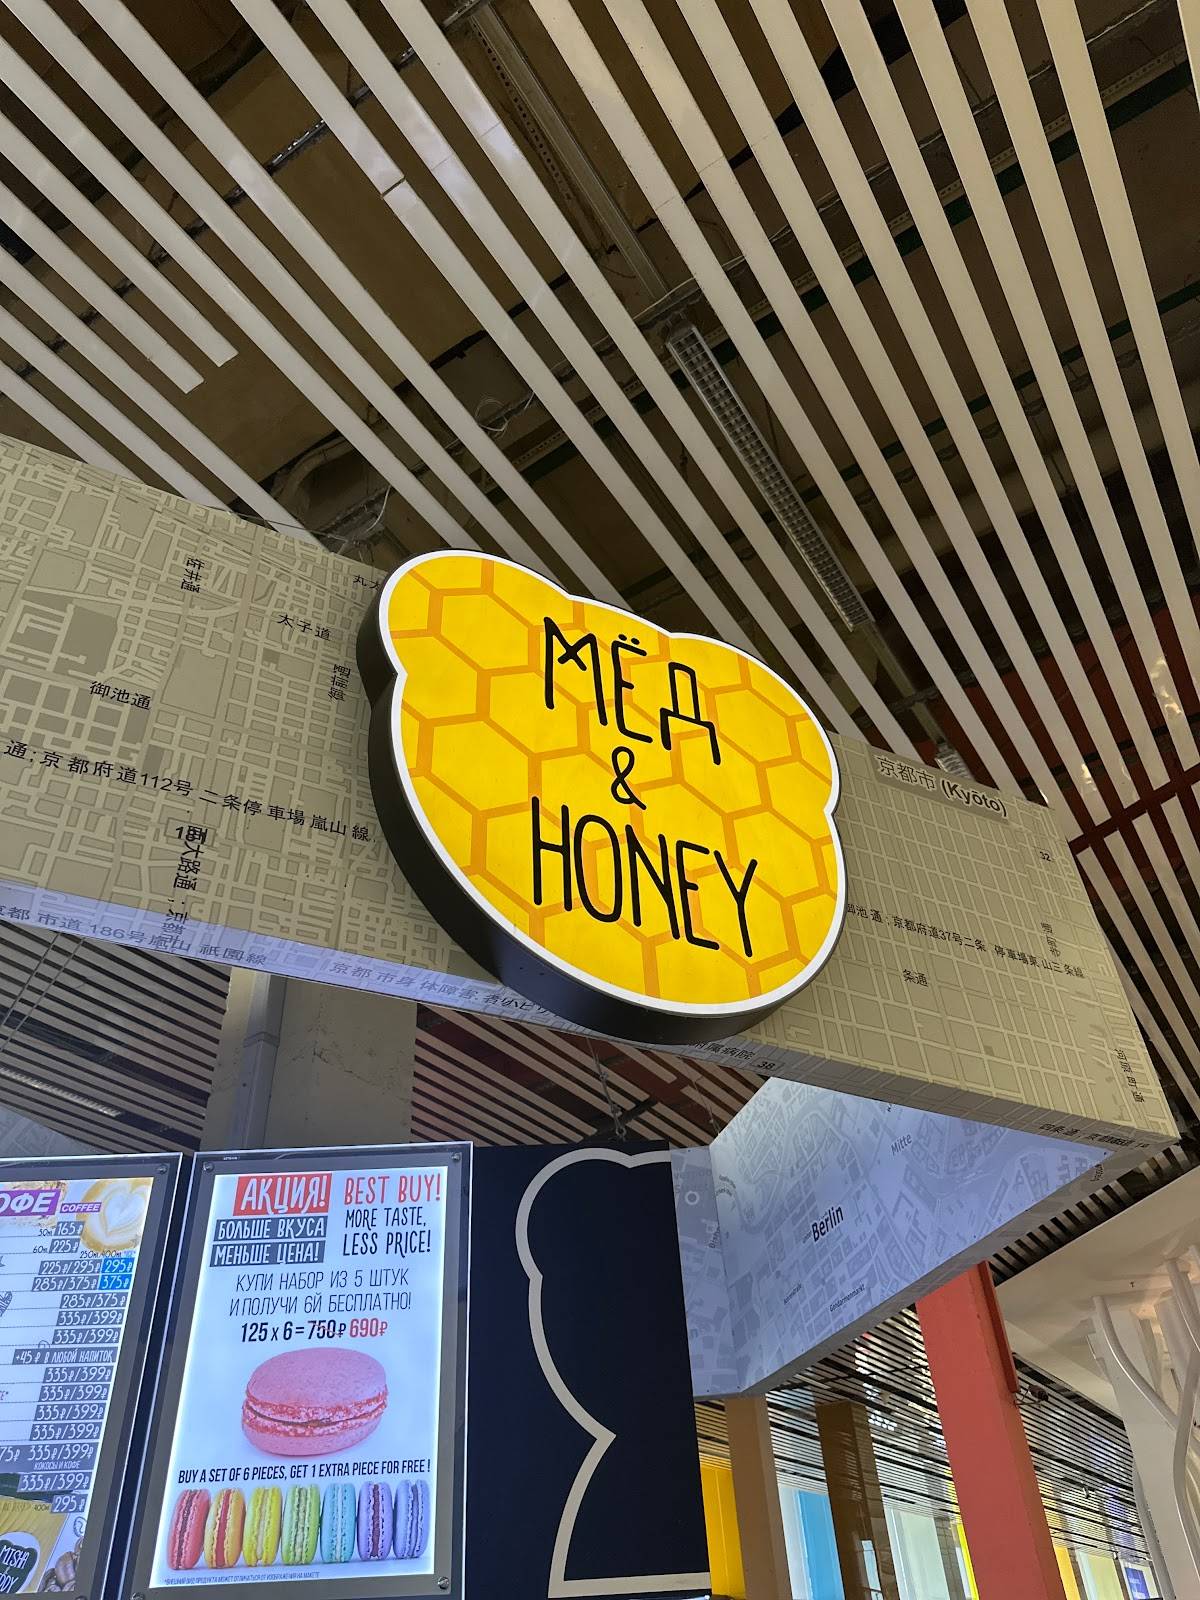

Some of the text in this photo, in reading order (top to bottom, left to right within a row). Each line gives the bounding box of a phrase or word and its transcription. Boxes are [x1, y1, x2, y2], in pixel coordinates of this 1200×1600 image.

[278, 613, 332, 642] 太子道
[89, 680, 153, 711] 御池通
[544, 616, 722, 766] МЁД
[611, 746, 647, 810] &
[877, 755, 1008, 818] 京都市 (Kyōto)
[531, 796, 758, 957] HONEY
[891, 1134, 912, 1156] Mitte
[241, 1176, 328, 1215] АКЦИЯ!
[344, 1173, 442, 1206] BEST BUY!
[61, 1203, 101, 1213] COFFEE
[345, 1206, 427, 1231] MORE TASTE,
[217, 1217, 325, 1240] БОЛЬШЕ ВКУСА
[811, 1206, 844, 1243] Berlin
[214, 1241, 320, 1266] МЕНЬШЕ ЦЕНА!
[343, 1229, 432, 1259] LESS PRICE!
[236, 1267, 410, 1292] КУПИ НАБОР ИЗ 5 ШТУК
[242, 1295, 299, 1317] ПОЛУЧИ
[304, 1293, 323, 1315] 6Й
[328, 1291, 413, 1314] БЕСПЛАТНО!
[241, 1321, 268, 1343] 125
[178, 1468, 199, 1484] BUY
[199, 1468, 208, 1483] A
[208, 1467, 228, 1482] SET
[229, 1467, 242, 1482] OF
[243, 1467, 250, 1481] 6
[251, 1465, 288, 1481] PIECES,
[290, 1464, 309, 1479] GET
[311, 1463, 317, 1478] 1
[319, 1462, 351, 1478] EXTRA
[352, 1461, 380, 1476] PIECE
[381, 1460, 400, 1475] FOR
